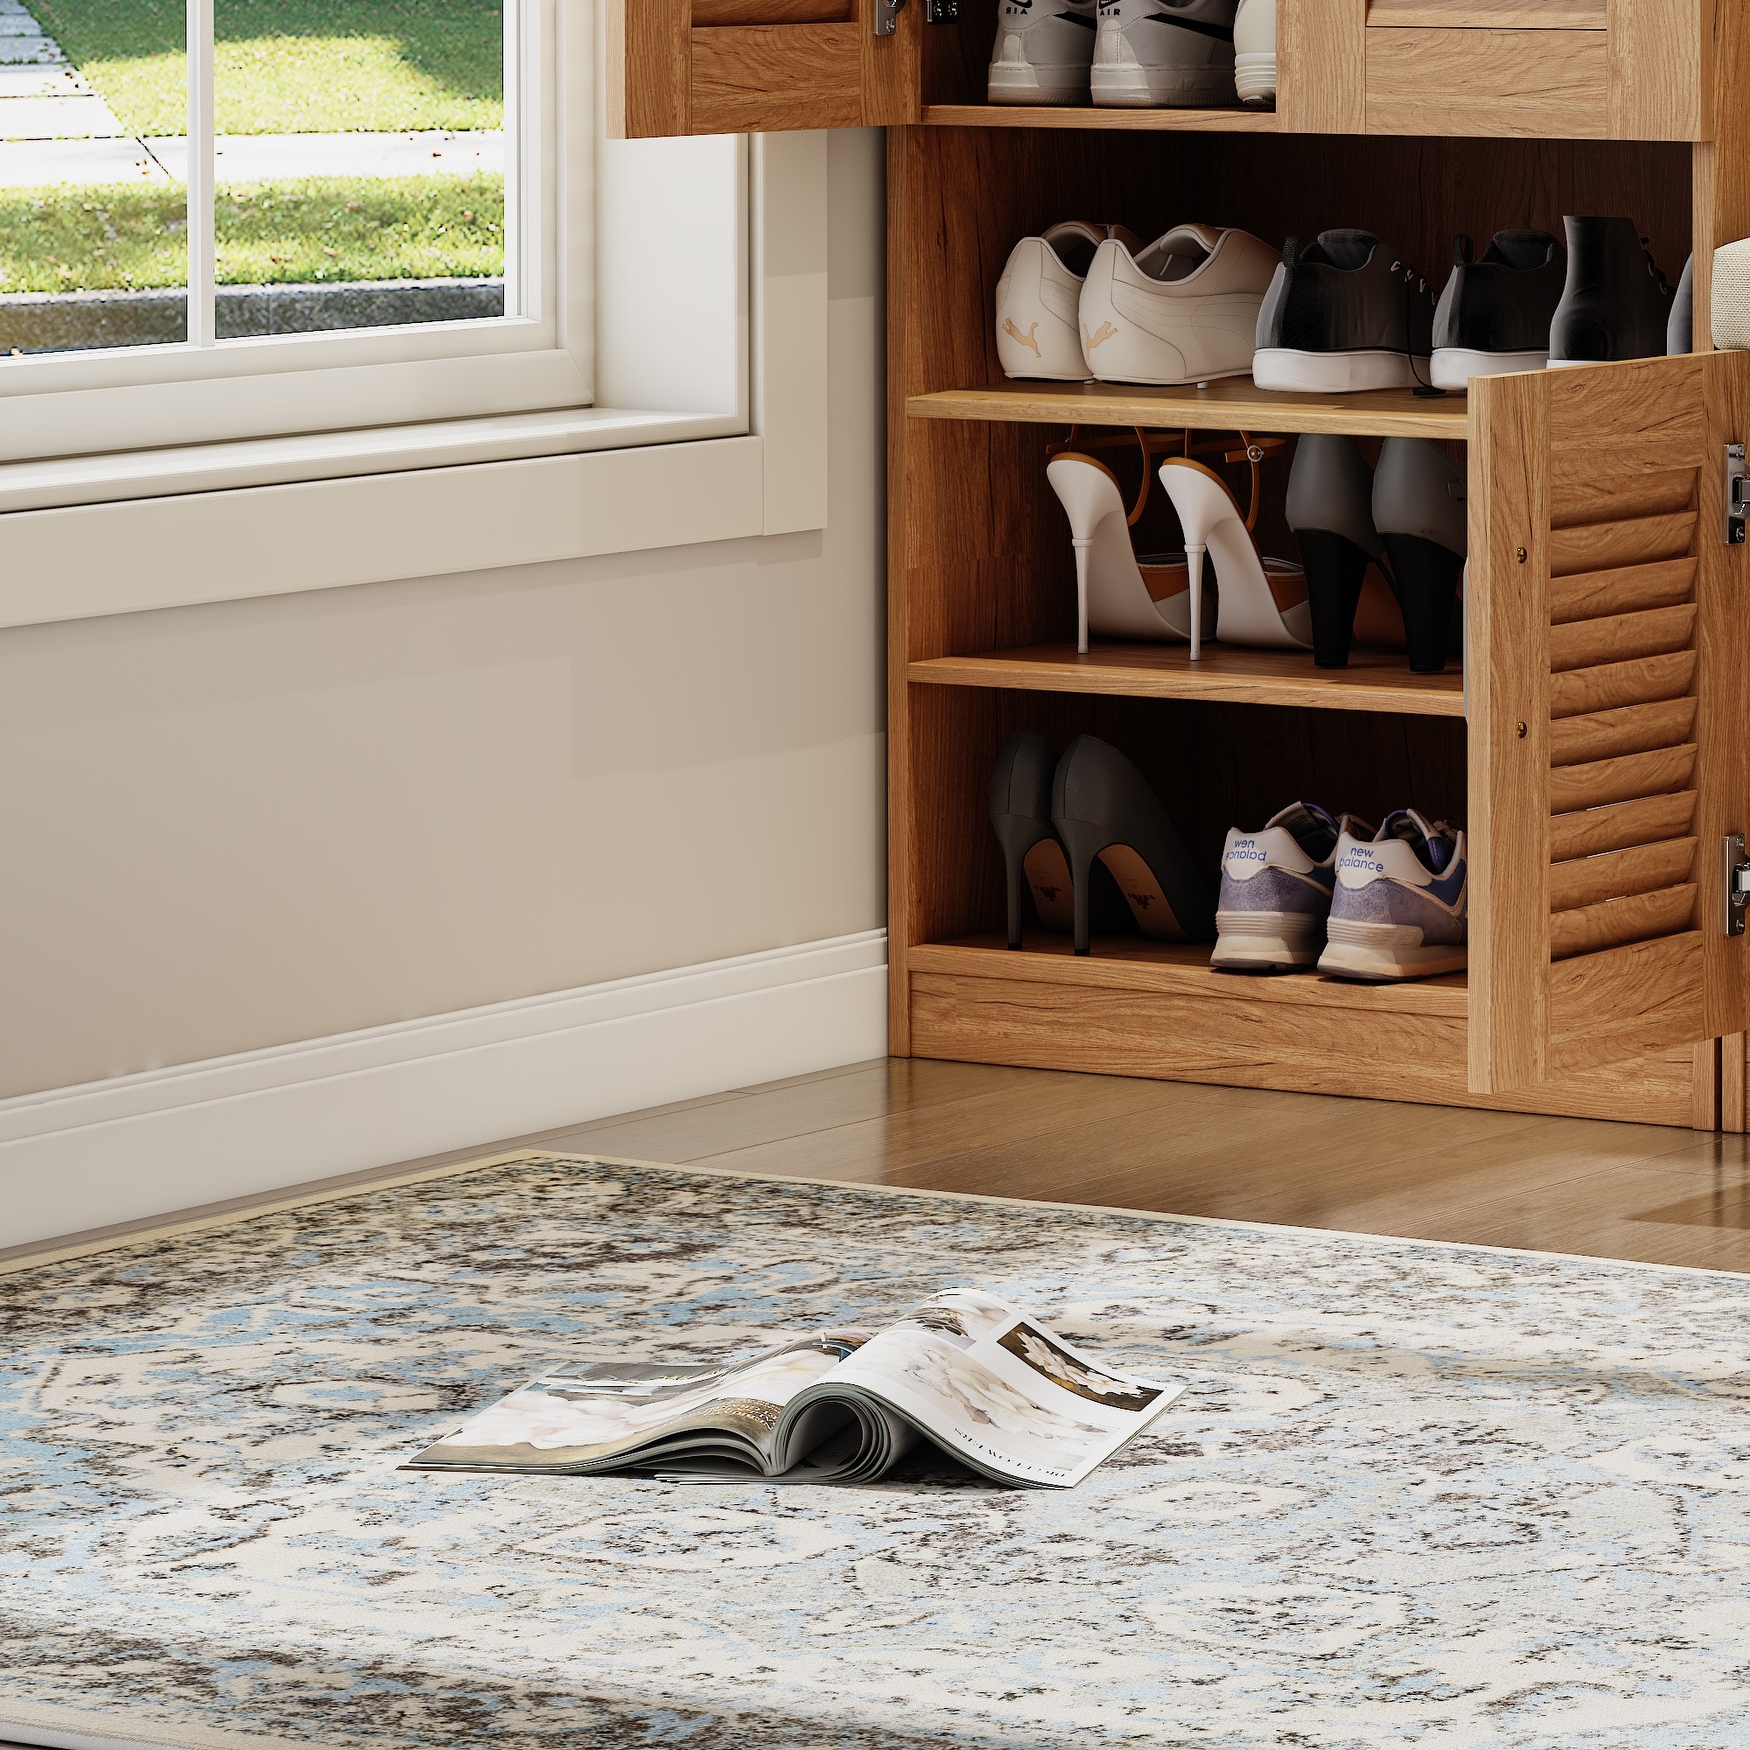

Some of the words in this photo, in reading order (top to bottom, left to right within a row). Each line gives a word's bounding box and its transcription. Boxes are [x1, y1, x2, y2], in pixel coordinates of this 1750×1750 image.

[1100, 8, 1121, 16] AIR
[1350, 847, 1374, 858] new
[1339, 855, 1384, 872] balance
